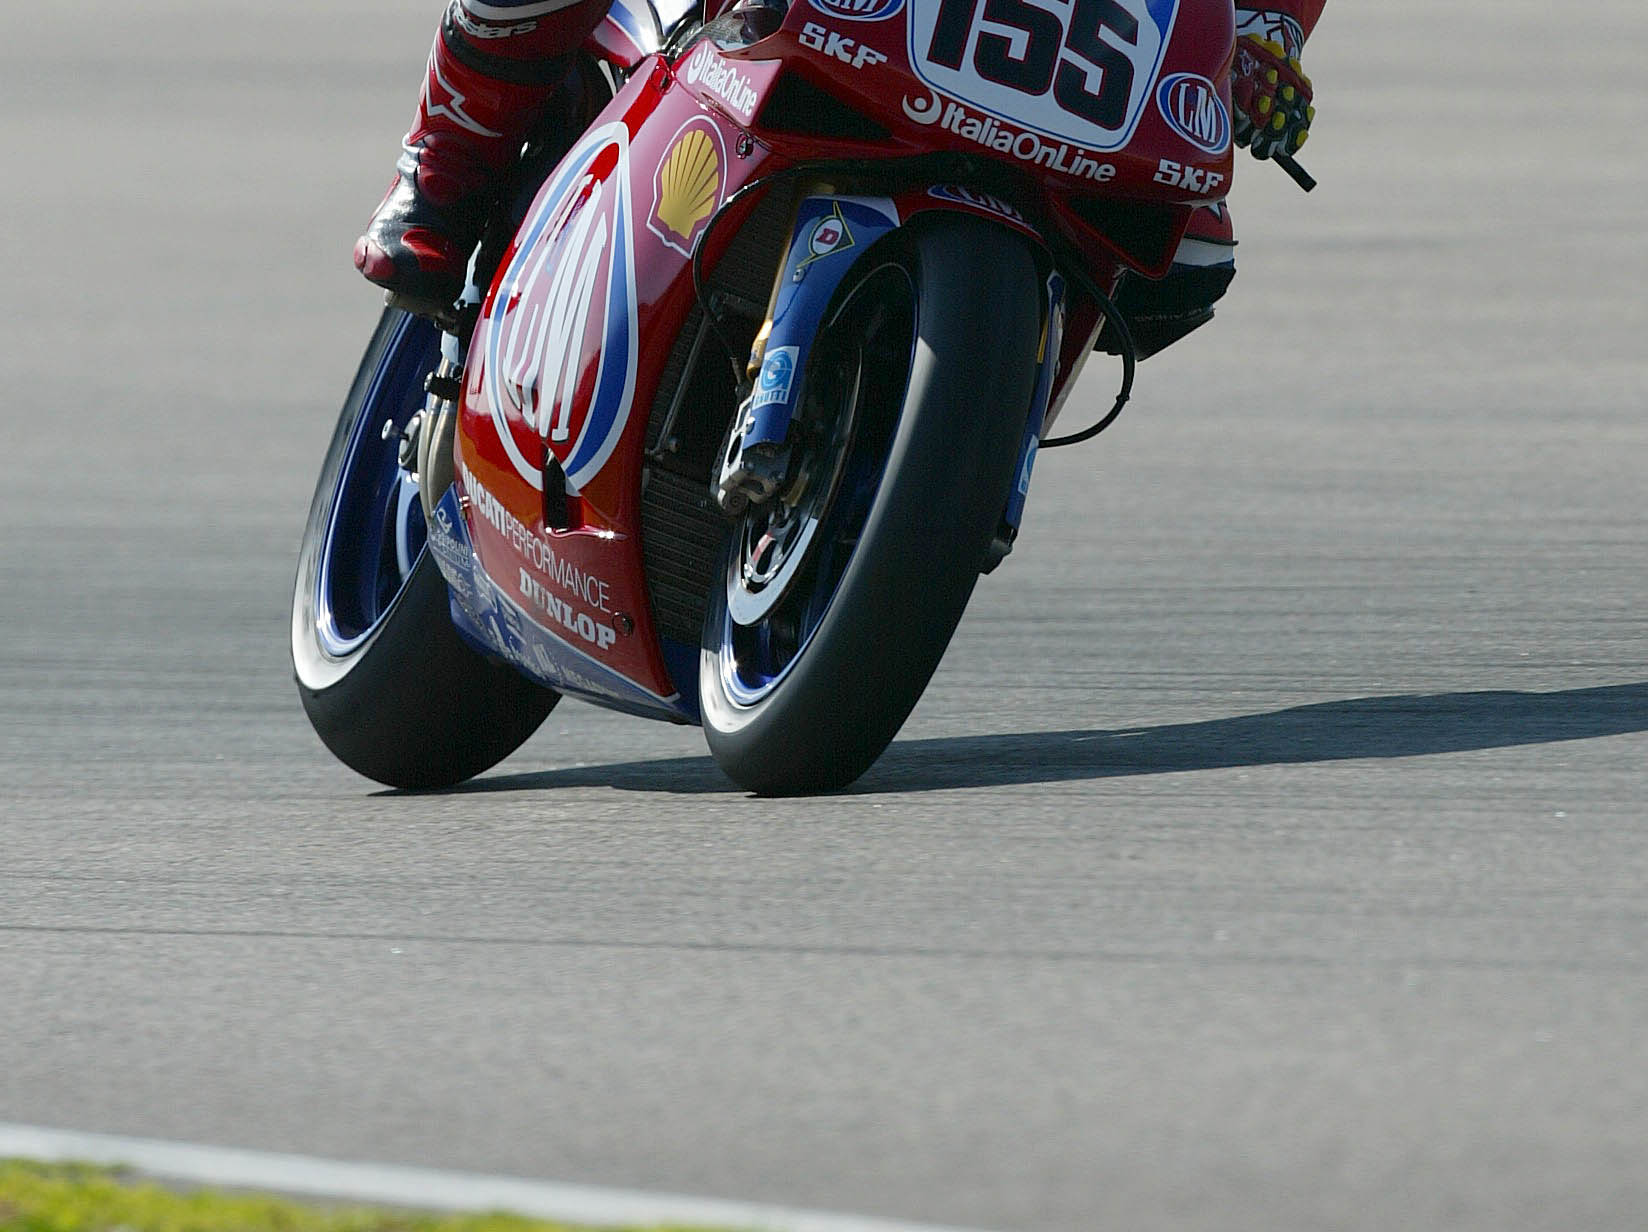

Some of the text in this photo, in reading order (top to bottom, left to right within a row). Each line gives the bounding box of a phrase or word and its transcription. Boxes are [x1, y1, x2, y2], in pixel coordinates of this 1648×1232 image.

[798, 22, 888, 69] SKF
[941, 101, 1117, 182] ItaliaOnLine
[1153, 159, 1224, 194] SKF
[518, 566, 617, 651] DUNLOP
